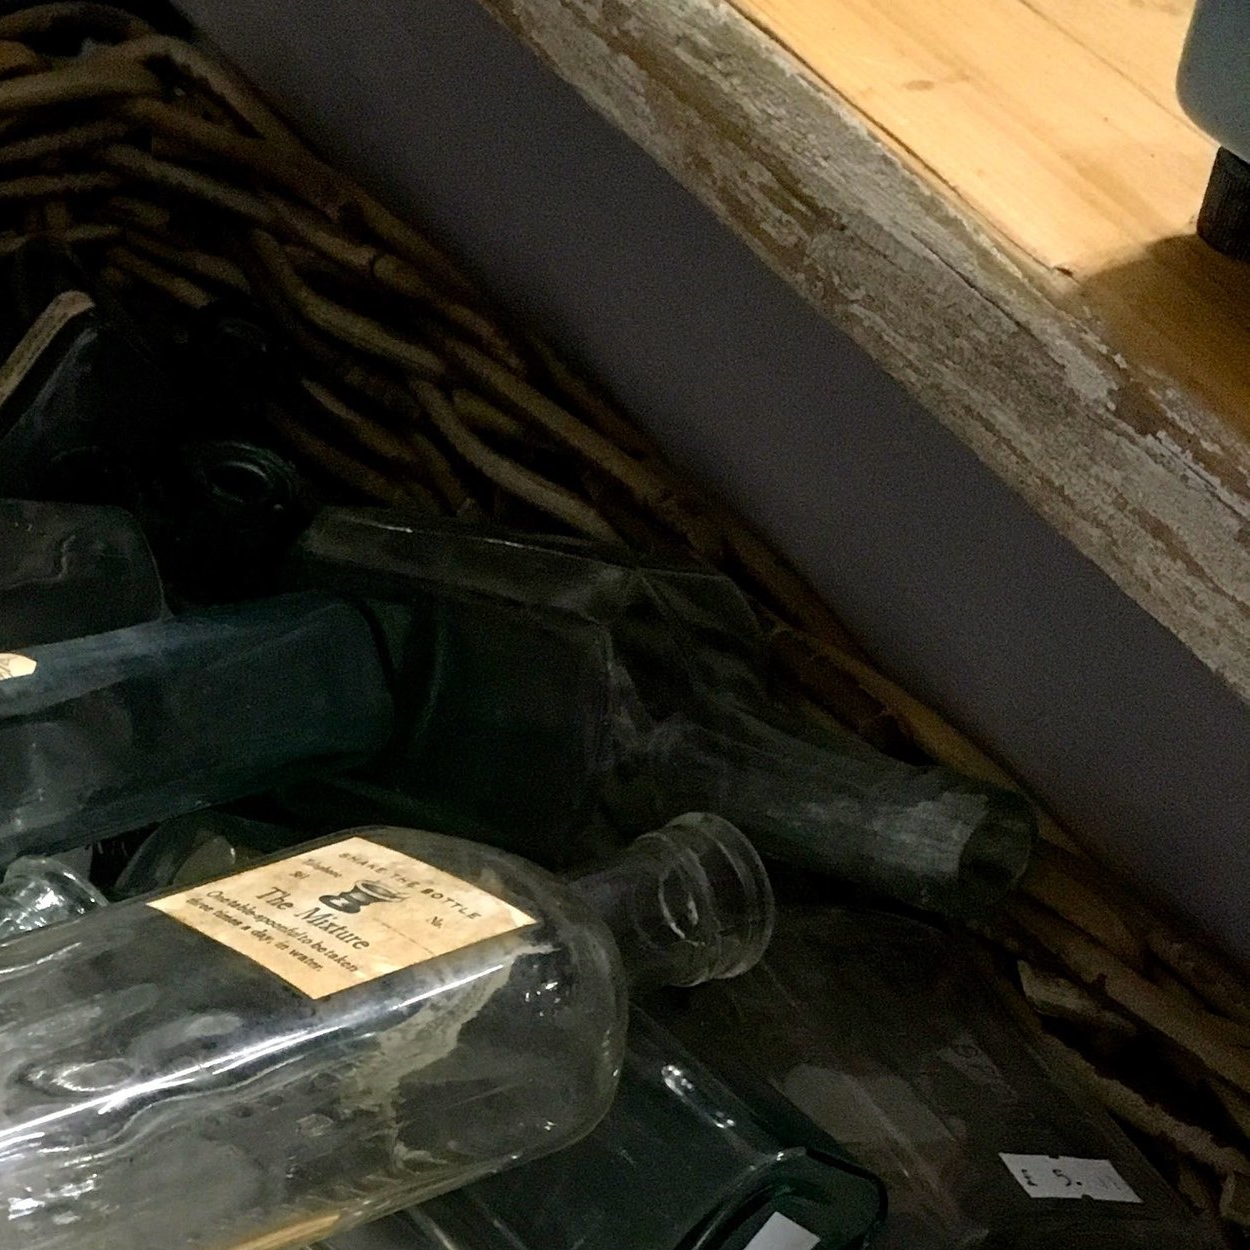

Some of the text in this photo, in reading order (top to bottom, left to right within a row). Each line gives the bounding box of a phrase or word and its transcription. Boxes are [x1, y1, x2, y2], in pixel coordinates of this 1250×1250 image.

[256, 886, 371, 951] The Mixture
[338, 852, 482, 920] SHAKE THE BOTTLE
